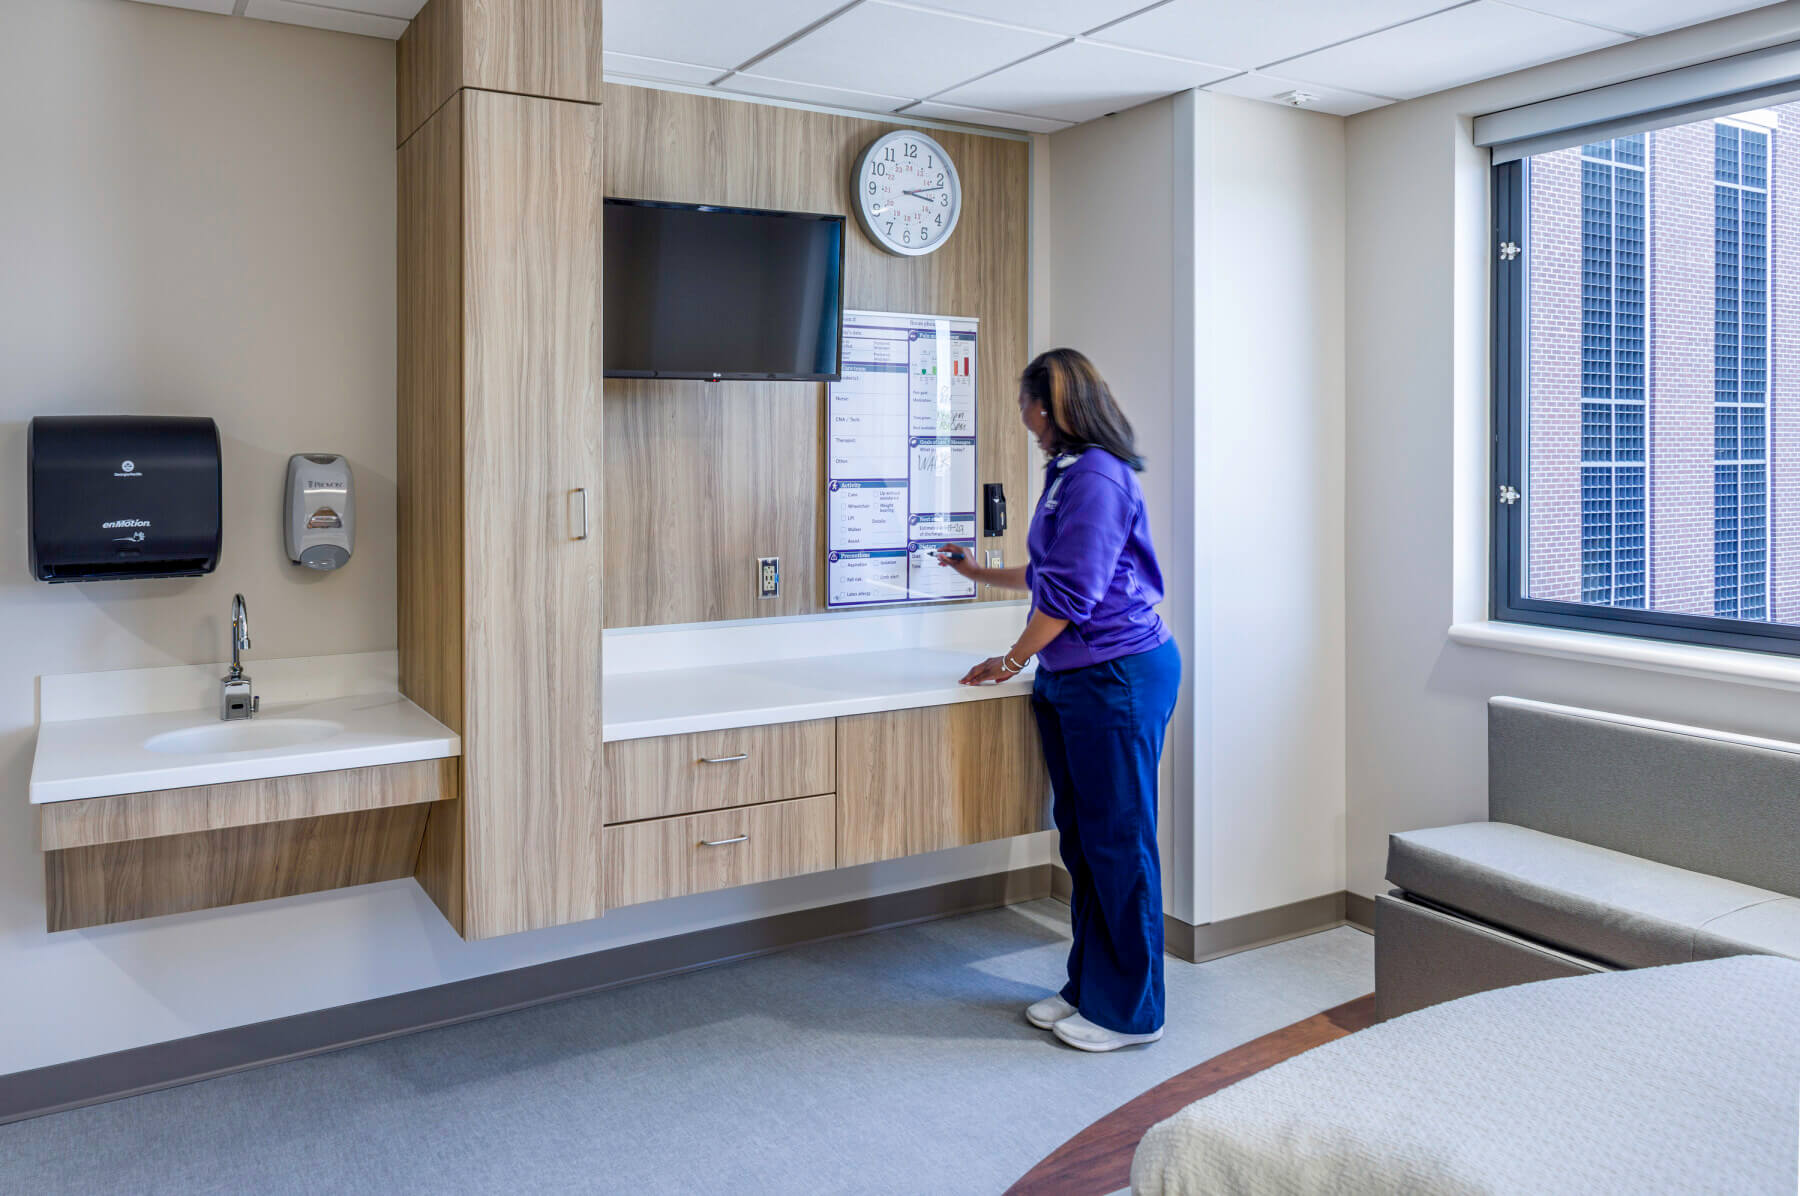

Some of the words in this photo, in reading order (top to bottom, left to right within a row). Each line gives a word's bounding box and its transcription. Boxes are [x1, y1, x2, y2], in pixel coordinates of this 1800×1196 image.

[885, 148, 895, 162] 11
[904, 143, 917, 158] 12
[928, 155, 932, 168] 1
[872, 162, 885, 176] 10
[937, 173, 944, 186] 2
[869, 181, 876, 195] 9
[941, 194, 948, 207] 3
[873, 203, 880, 217] 8
[935, 214, 942, 226] 4
[886, 221, 893, 235] 7
[921, 227, 928, 240] 5
[903, 230, 910, 243] 6
[102, 519, 151, 529] enMotion
